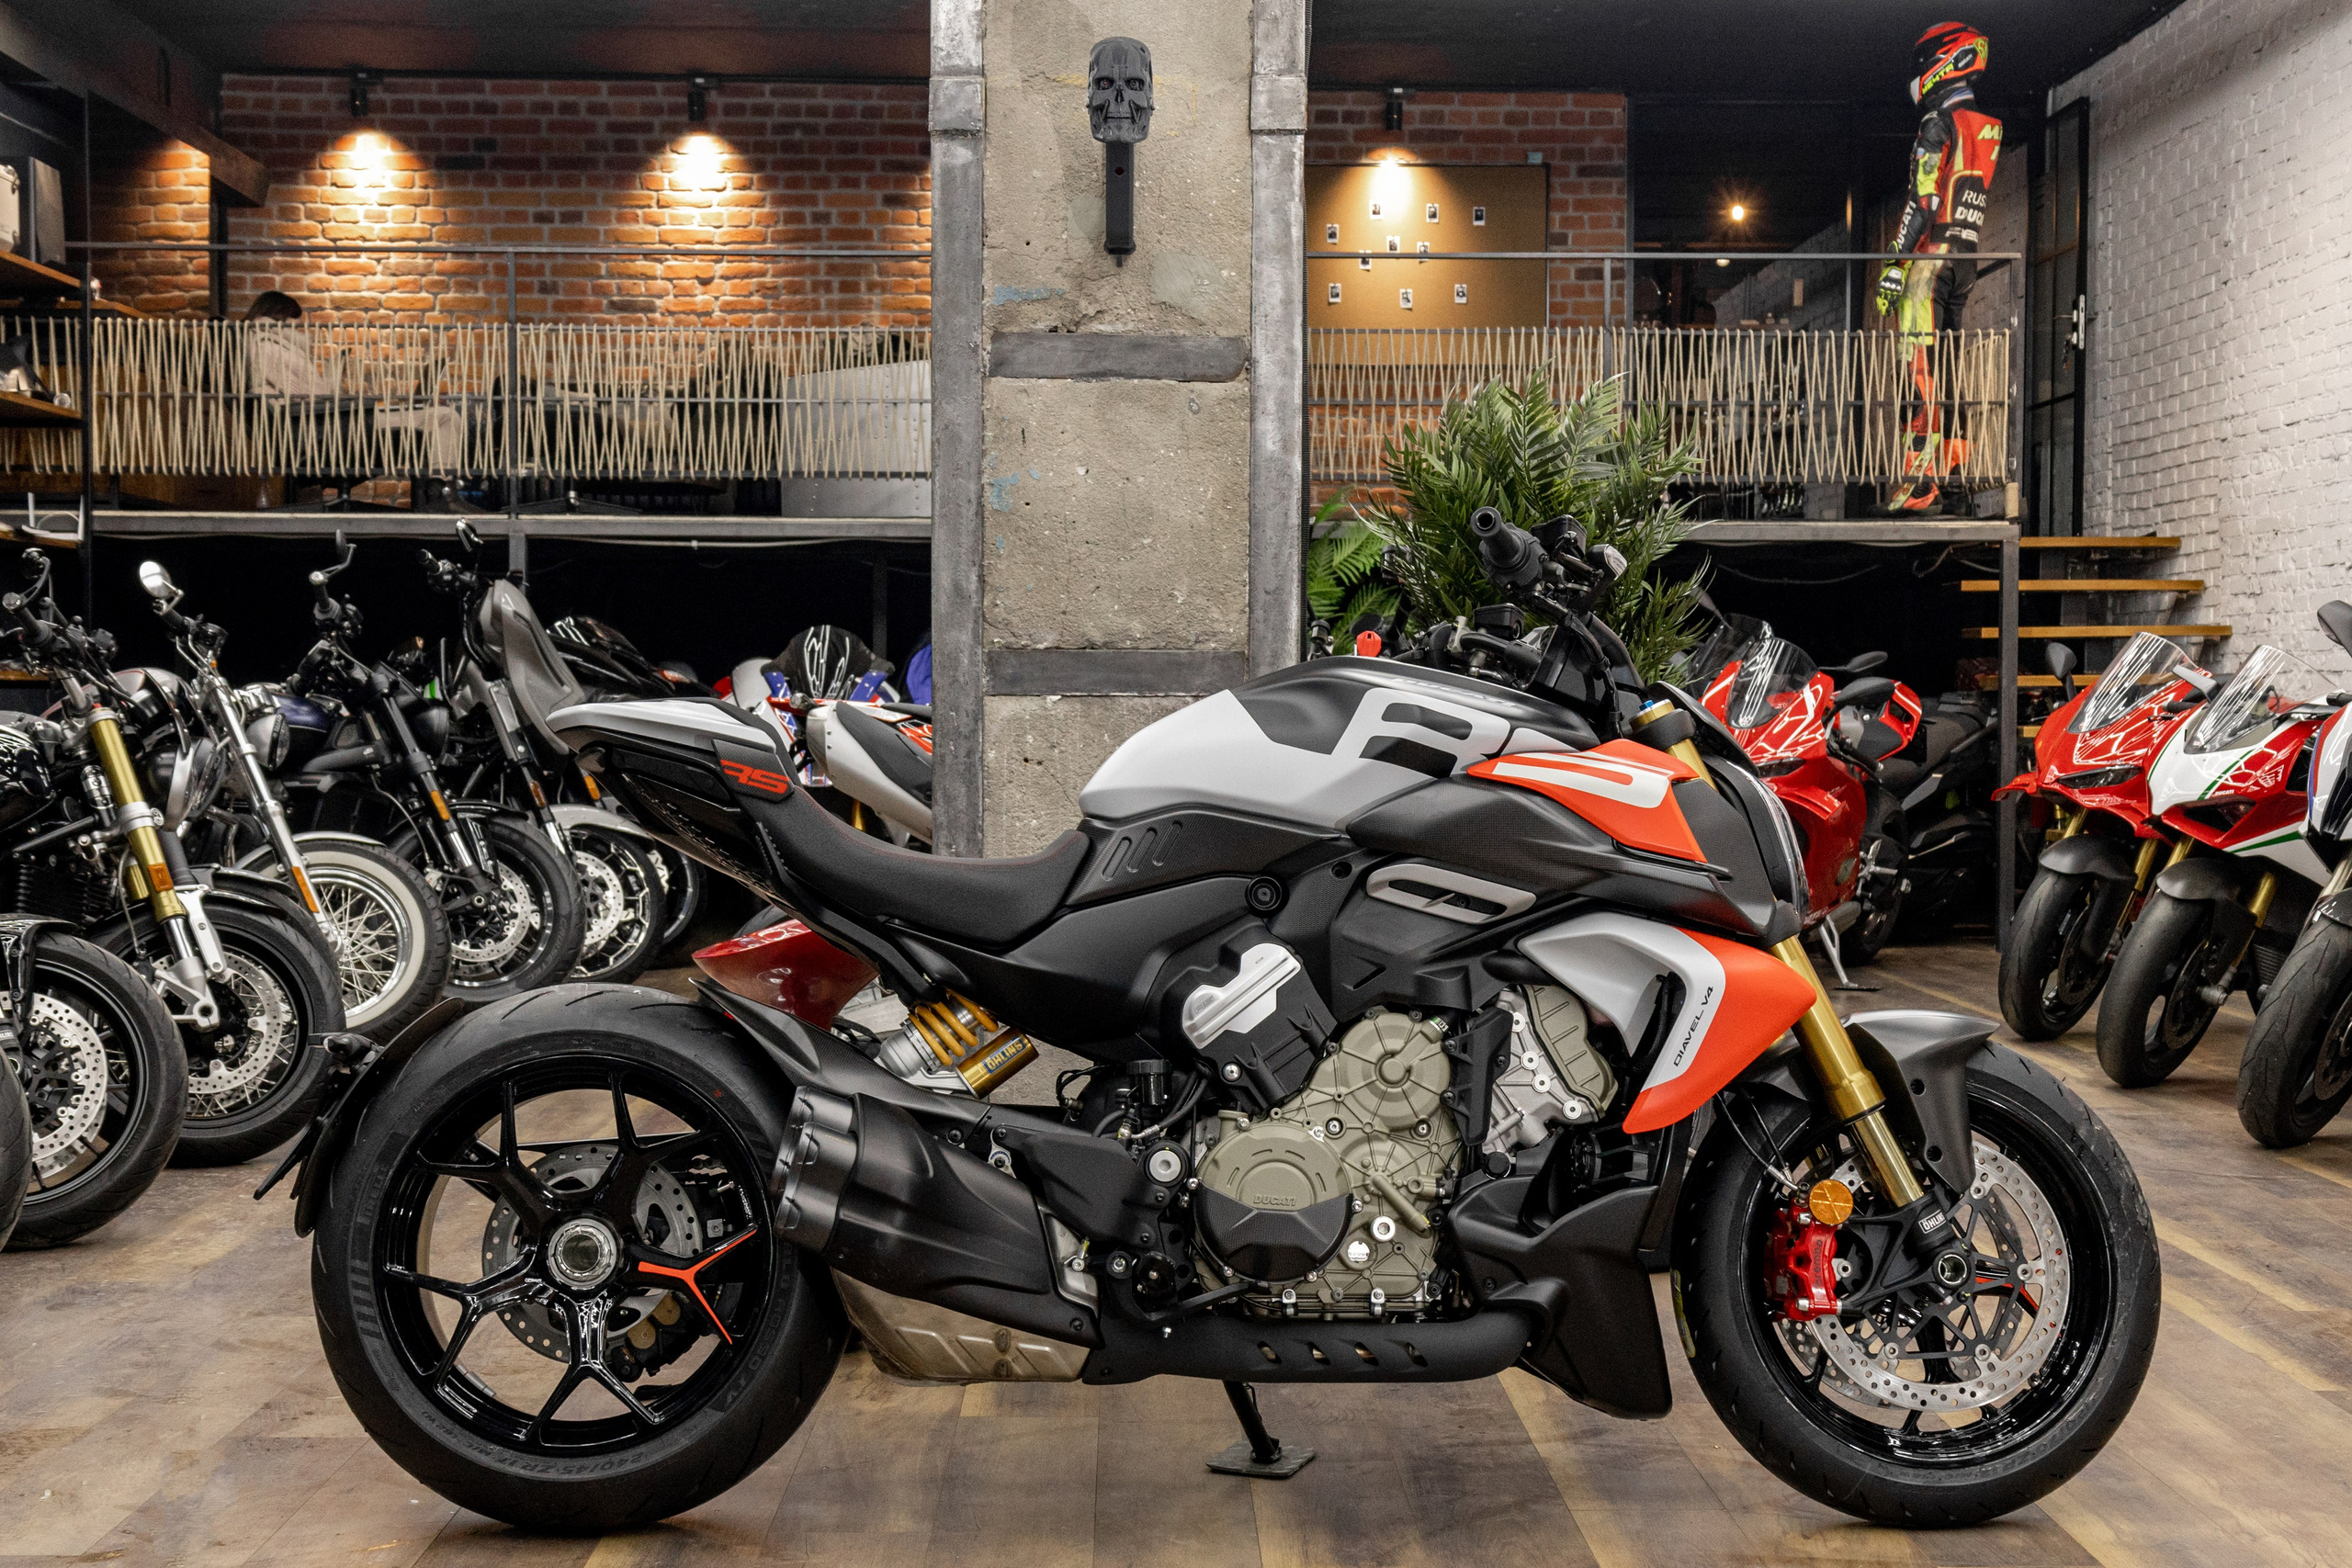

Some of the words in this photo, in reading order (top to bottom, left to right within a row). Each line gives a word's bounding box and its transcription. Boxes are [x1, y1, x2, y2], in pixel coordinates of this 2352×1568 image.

[1391, 678, 1516, 706] DUCATI
[719, 759, 791, 795] RS
[1673, 1010, 1704, 1067] DIAVEL
[1701, 986, 1714, 1006] V4
[1252, 1195, 1297, 1207] DUCATI
[747, 1298, 786, 1372] ROSSO
